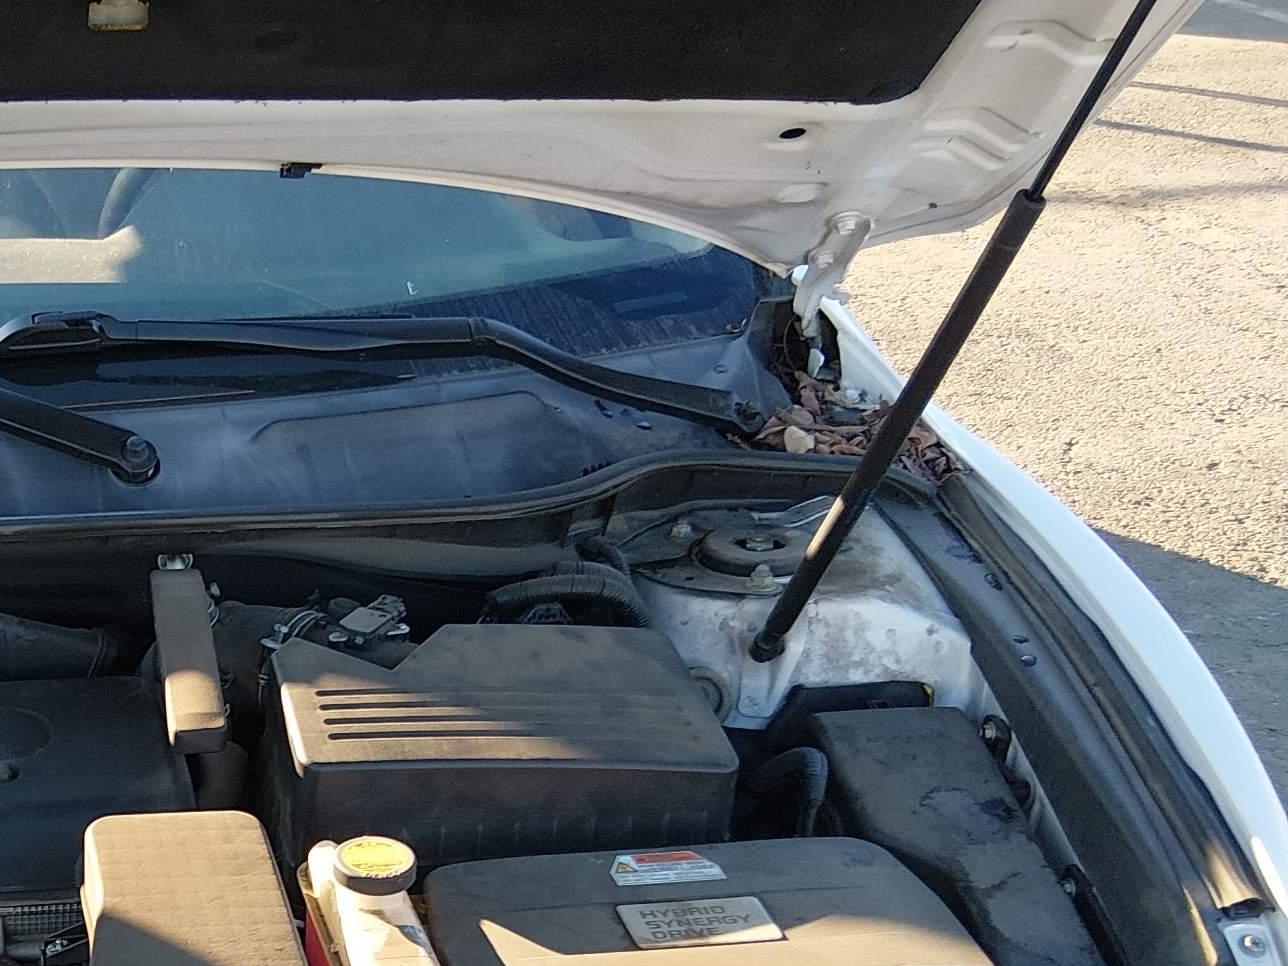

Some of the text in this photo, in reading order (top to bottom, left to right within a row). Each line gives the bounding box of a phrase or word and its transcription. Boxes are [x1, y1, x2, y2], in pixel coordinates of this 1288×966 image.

[639, 905, 725, 920] HYBRID
[644, 913, 751, 930] SYNERGY
[650, 927, 722, 940] DRIVE
